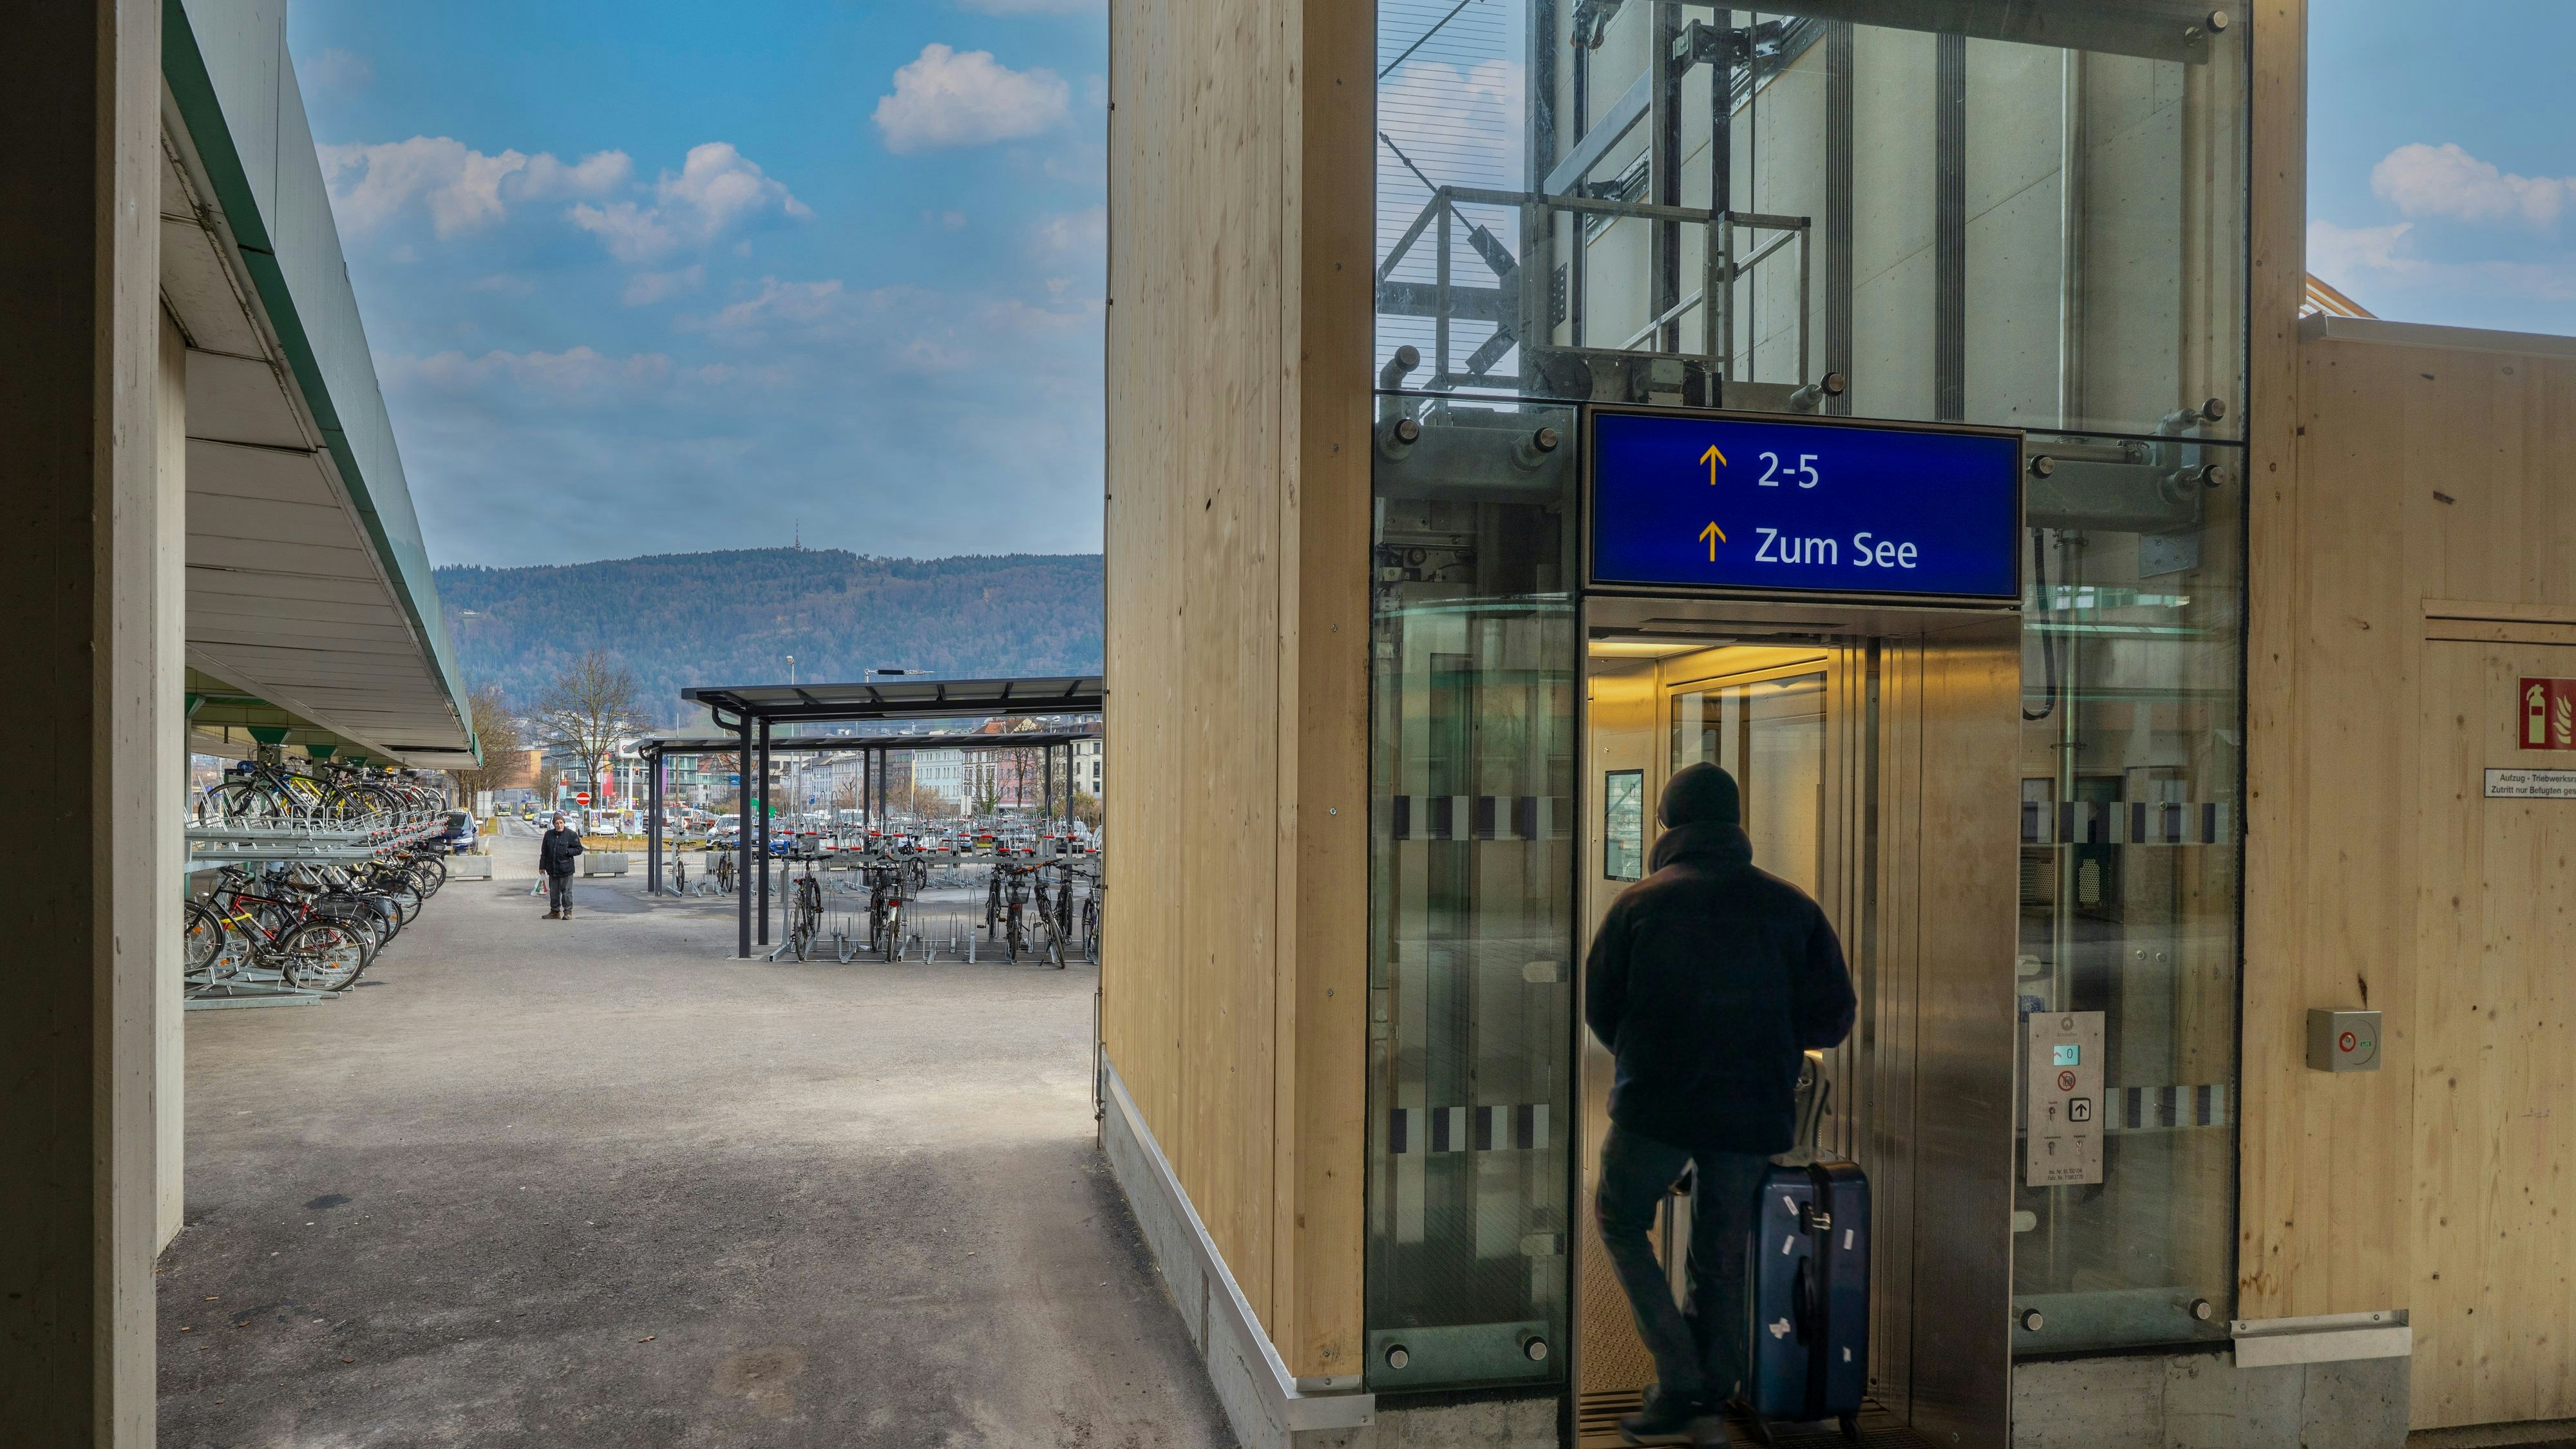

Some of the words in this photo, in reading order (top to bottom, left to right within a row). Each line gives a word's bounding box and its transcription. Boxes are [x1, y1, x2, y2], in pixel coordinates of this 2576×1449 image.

[1758, 451, 1819, 489] 2-5
[1755, 527, 1837, 565] Zum
[1853, 532, 1918, 569] See
[2499, 774, 2525, 783] Aufzug
[2530, 786, 2562, 795] Befugten
[2067, 1048, 2073, 1059] 0
